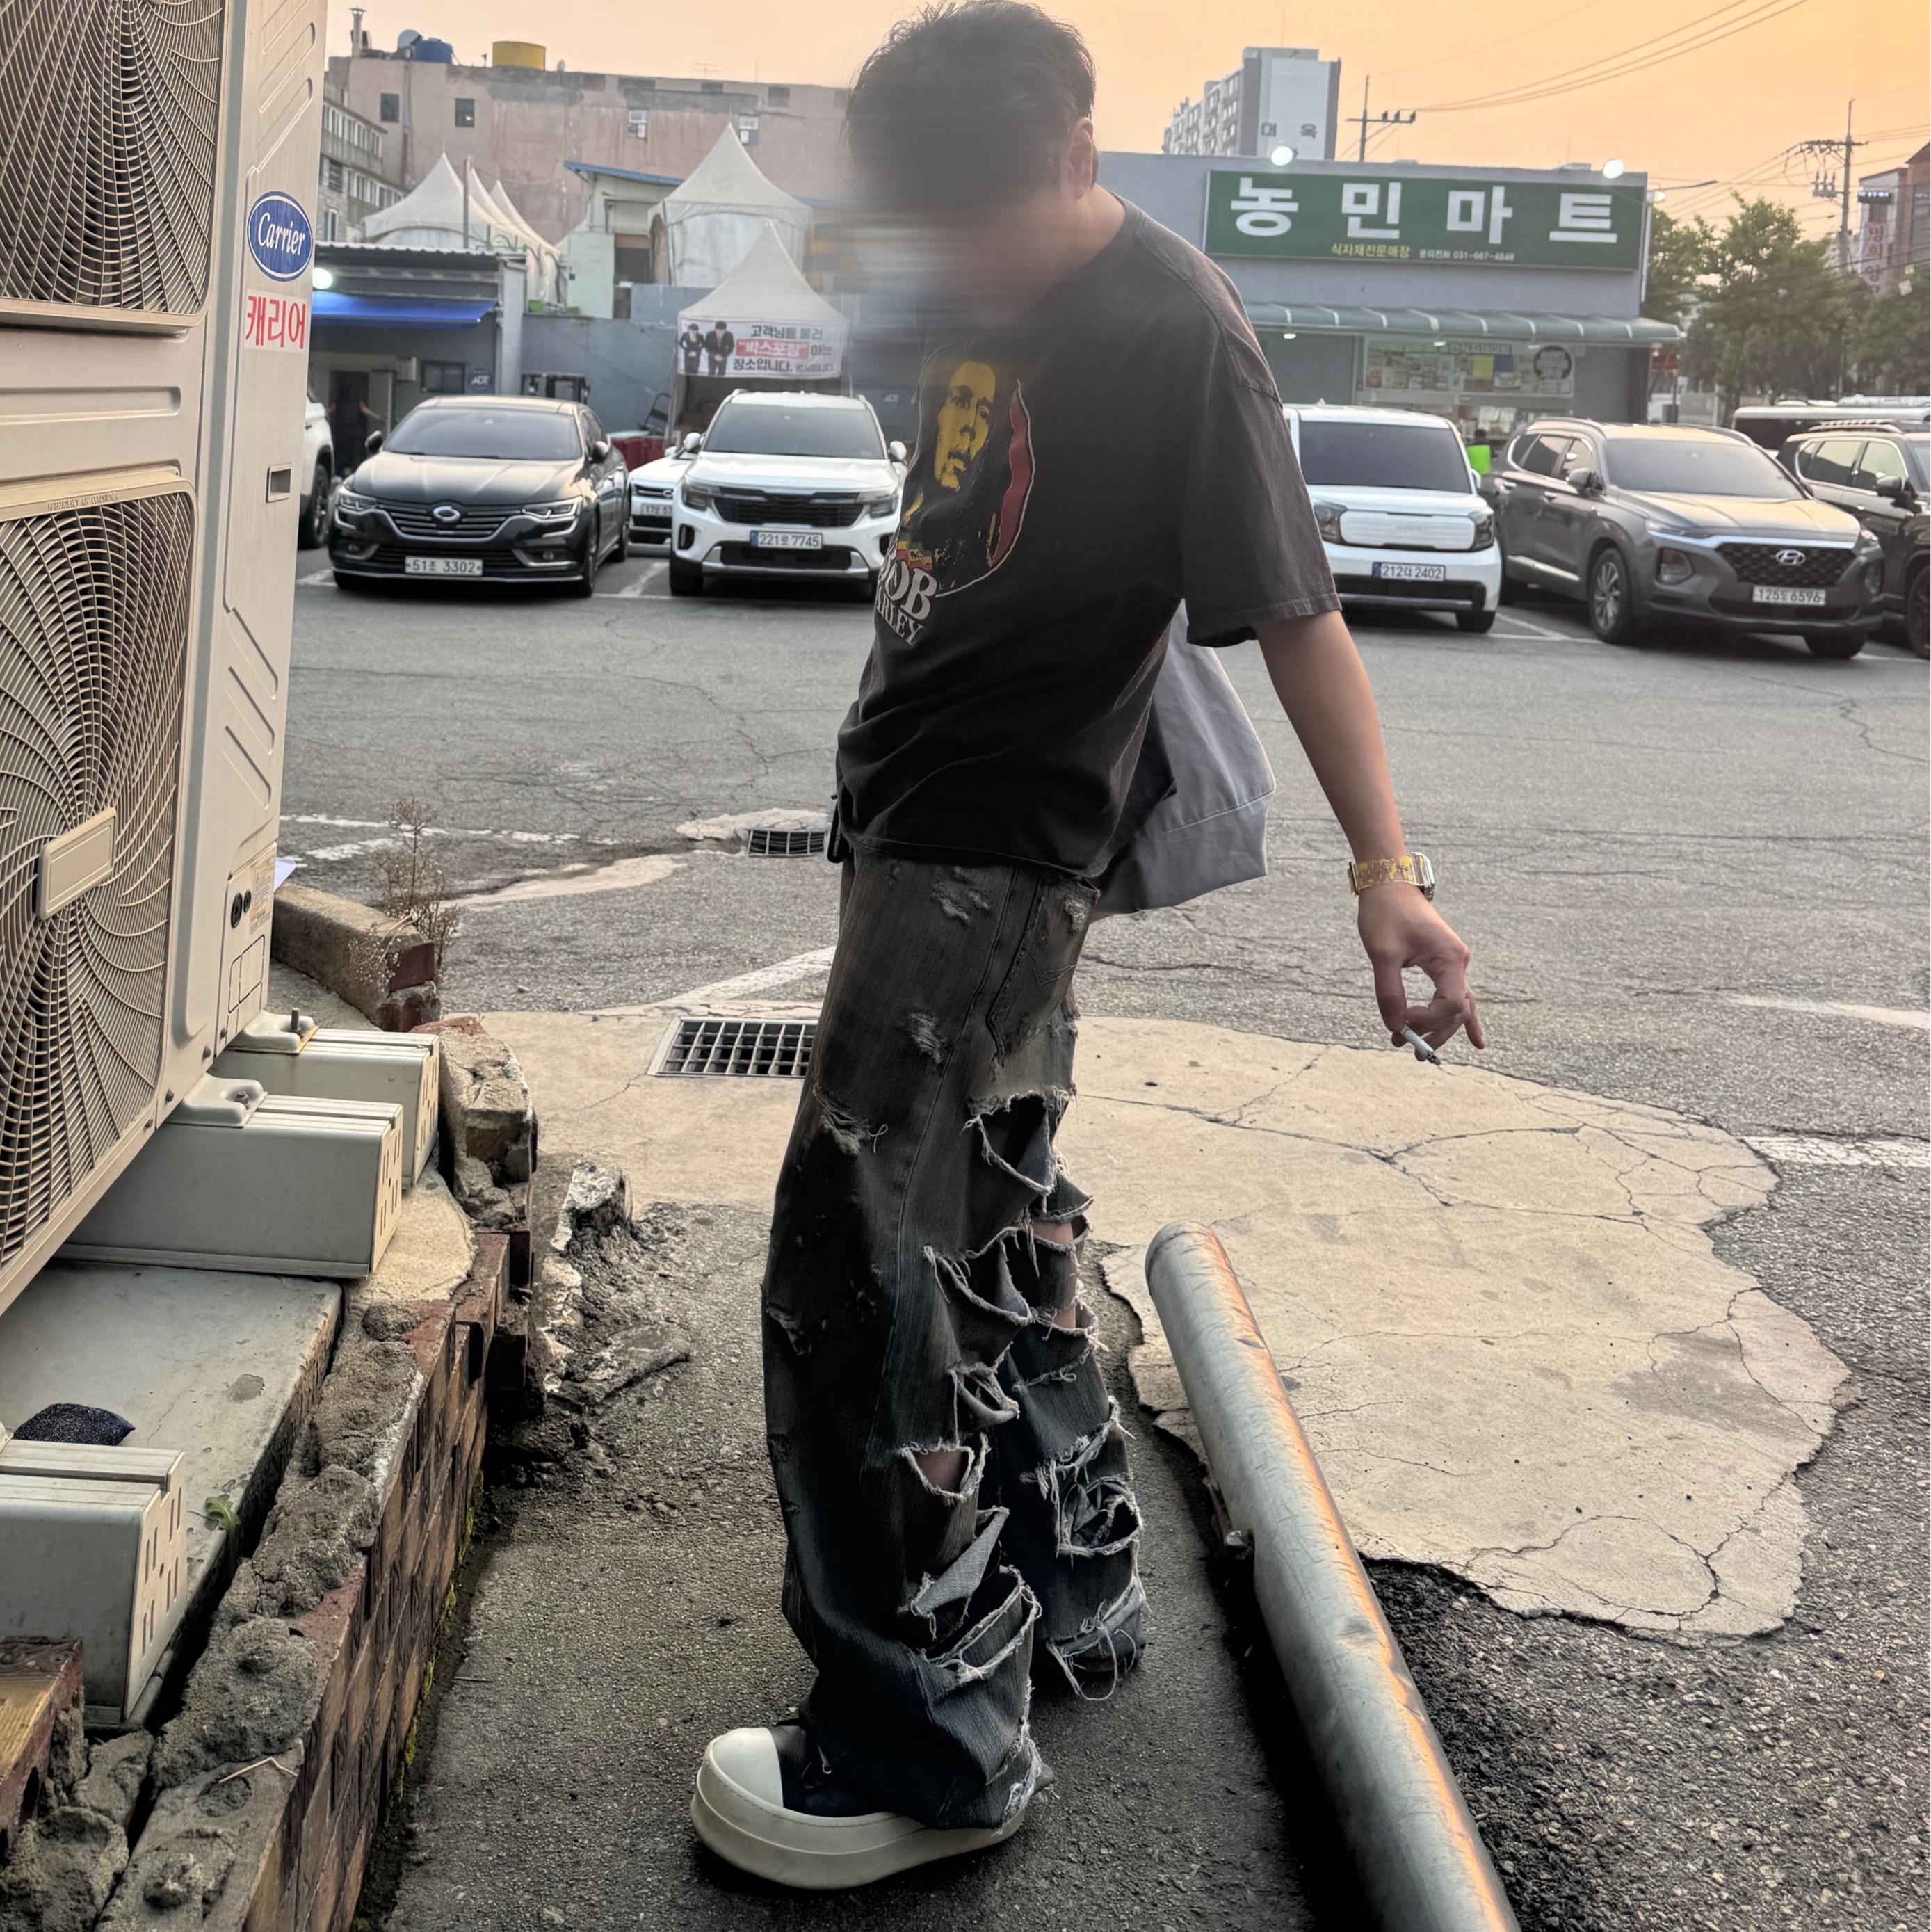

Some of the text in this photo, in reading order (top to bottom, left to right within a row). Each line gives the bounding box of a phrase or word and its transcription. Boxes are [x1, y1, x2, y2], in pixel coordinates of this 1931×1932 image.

[1230, 177, 1617, 244] 농민마트
[258, 212, 305, 255] Carrier
[245, 296, 306, 349] 캐리어
[791, 535, 819, 547] 7745
[443, 560, 476, 573] 3302
[1414, 566, 1441, 579] 2402
[1790, 590, 1820, 603] 6596
